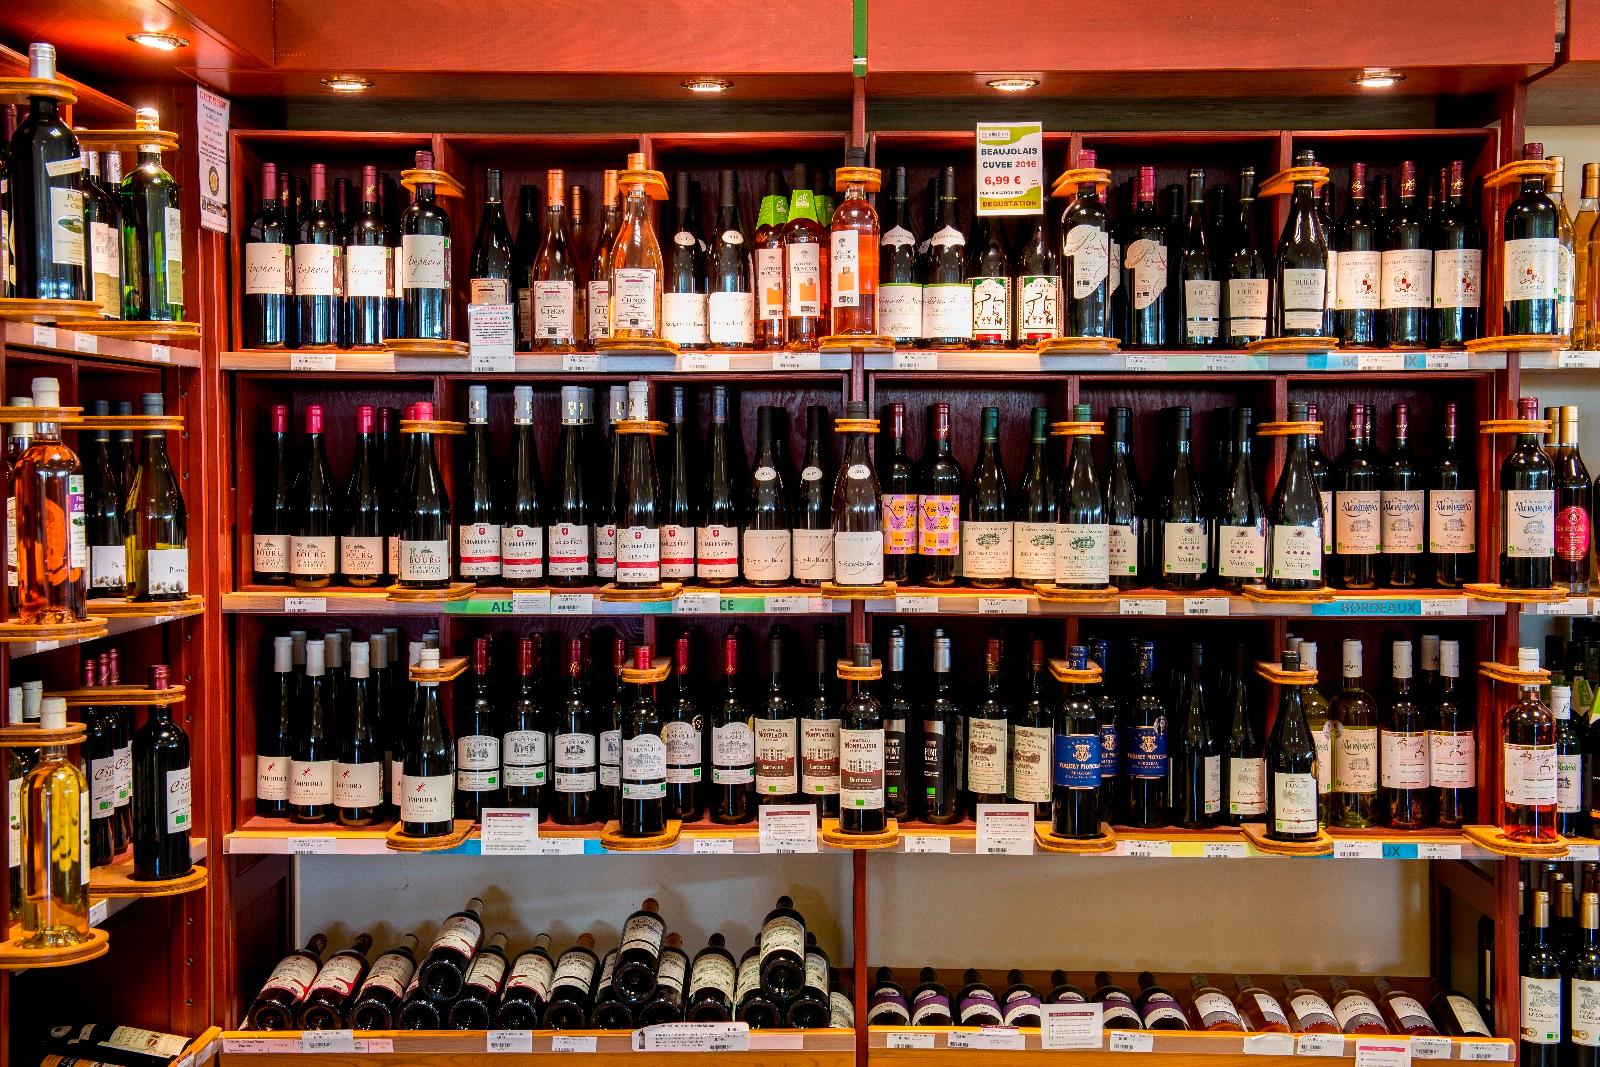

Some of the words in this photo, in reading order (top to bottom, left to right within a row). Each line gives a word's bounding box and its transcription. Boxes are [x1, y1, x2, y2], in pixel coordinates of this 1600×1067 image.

[981, 147, 1039, 156] BEAUJOLAIS
[983, 161, 1013, 169] CUVEE
[1015, 160, 1037, 168] 2016
[984, 175, 1010, 187] 6,99
[1014, 175, 1022, 185] €
[982, 200, 1037, 208] DEGUSTATION
[409, 556, 441, 565] BOURG
[491, 600, 514, 614] ALS
[1341, 601, 1416, 615] BORDEAUX
[845, 741, 877, 749] MONPLAISIR
